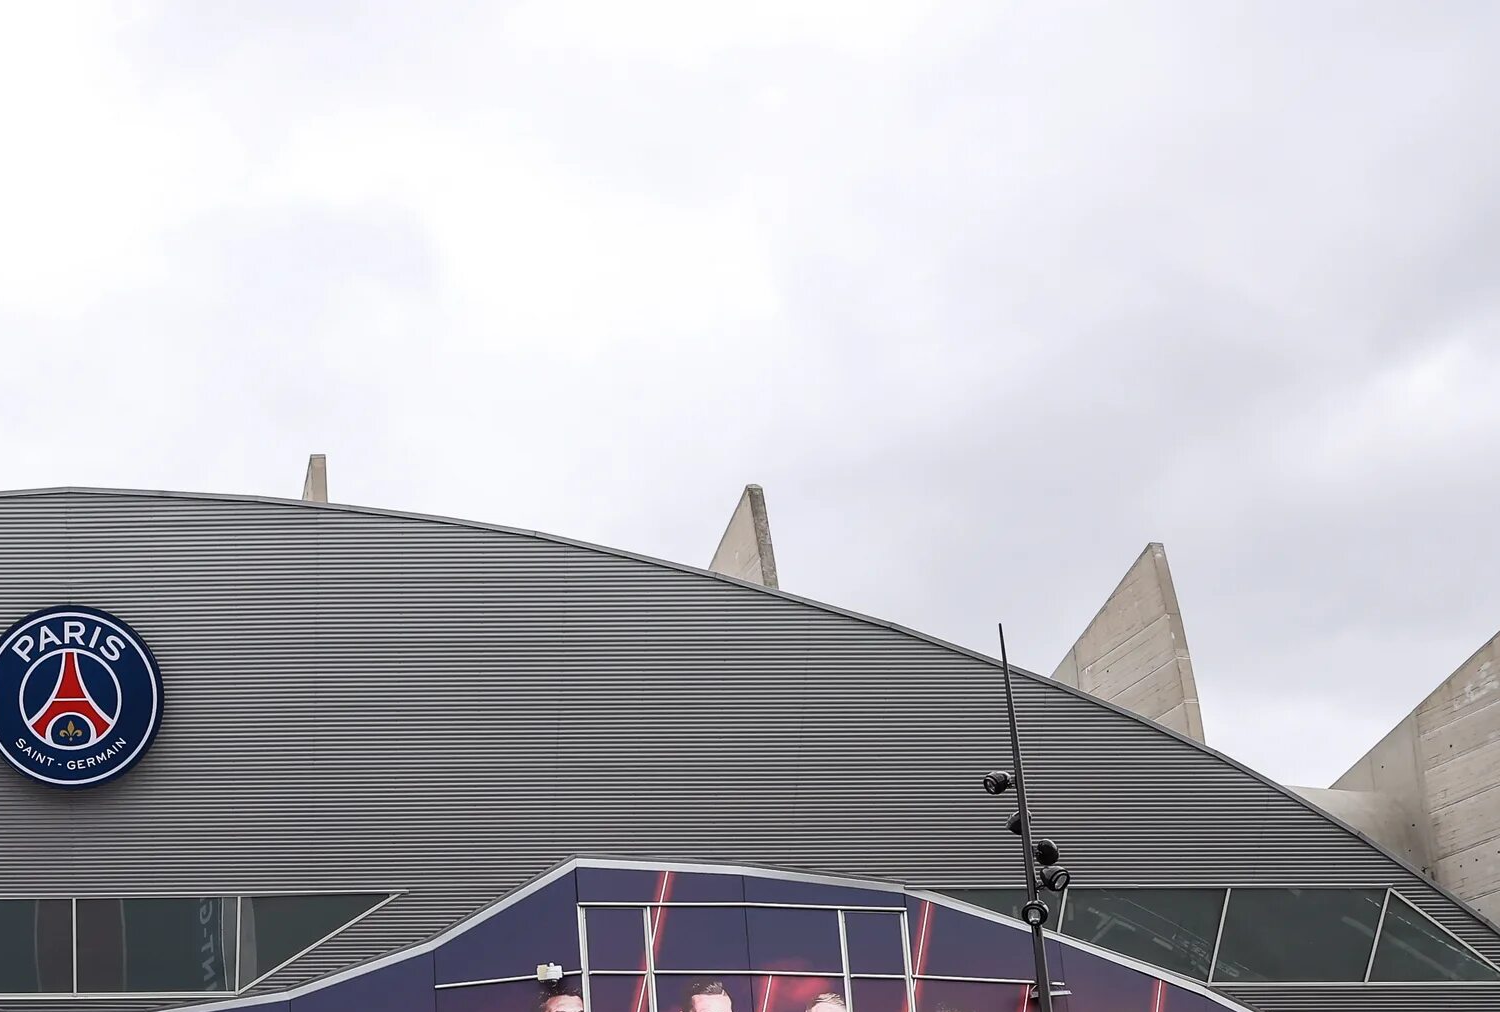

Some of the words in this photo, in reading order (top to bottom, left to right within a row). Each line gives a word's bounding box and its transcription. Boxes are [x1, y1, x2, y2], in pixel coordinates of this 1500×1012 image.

[11, 621, 126, 663] PARIS
[15, 738, 54, 767] SAINT
[66, 738, 127, 770] GERMAIN
